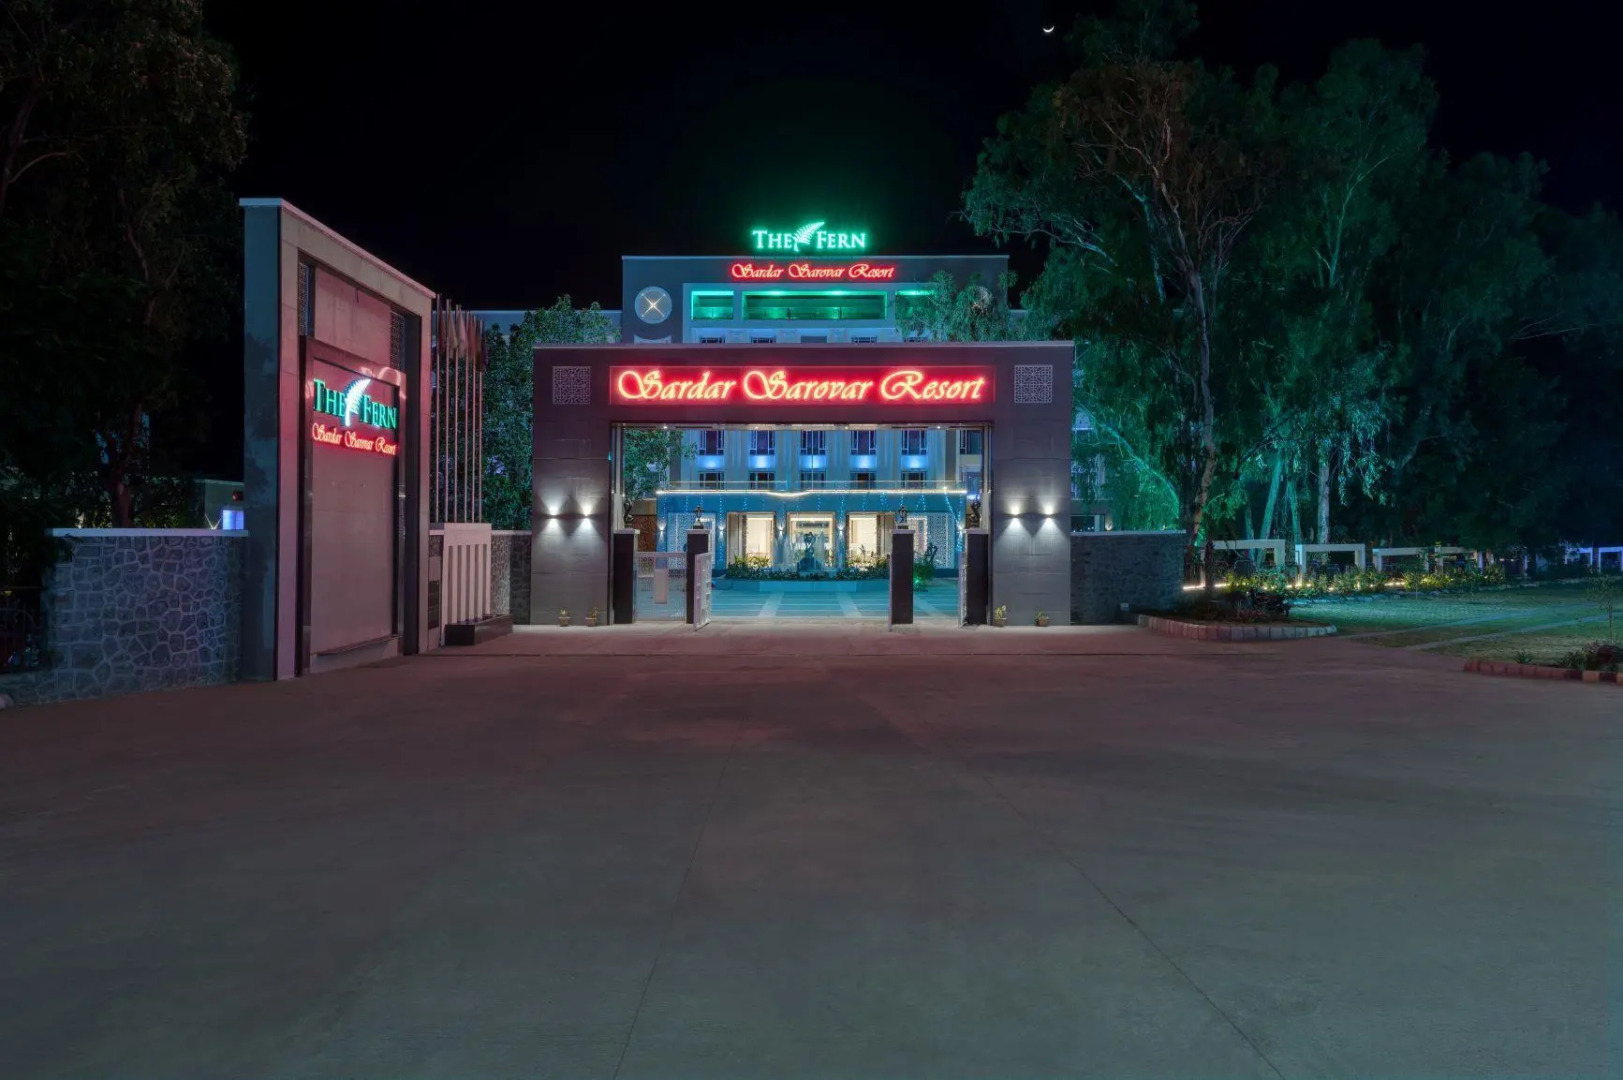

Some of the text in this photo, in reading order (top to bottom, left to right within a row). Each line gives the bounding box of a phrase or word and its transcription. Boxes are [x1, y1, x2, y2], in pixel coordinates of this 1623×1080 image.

[752, 229, 866, 249] THE FERN
[731, 263, 895, 278] Sardar Sarovar Resort
[617, 370, 985, 400] Sardar Sarovar Resort
[313, 378, 397, 429] THE FERN
